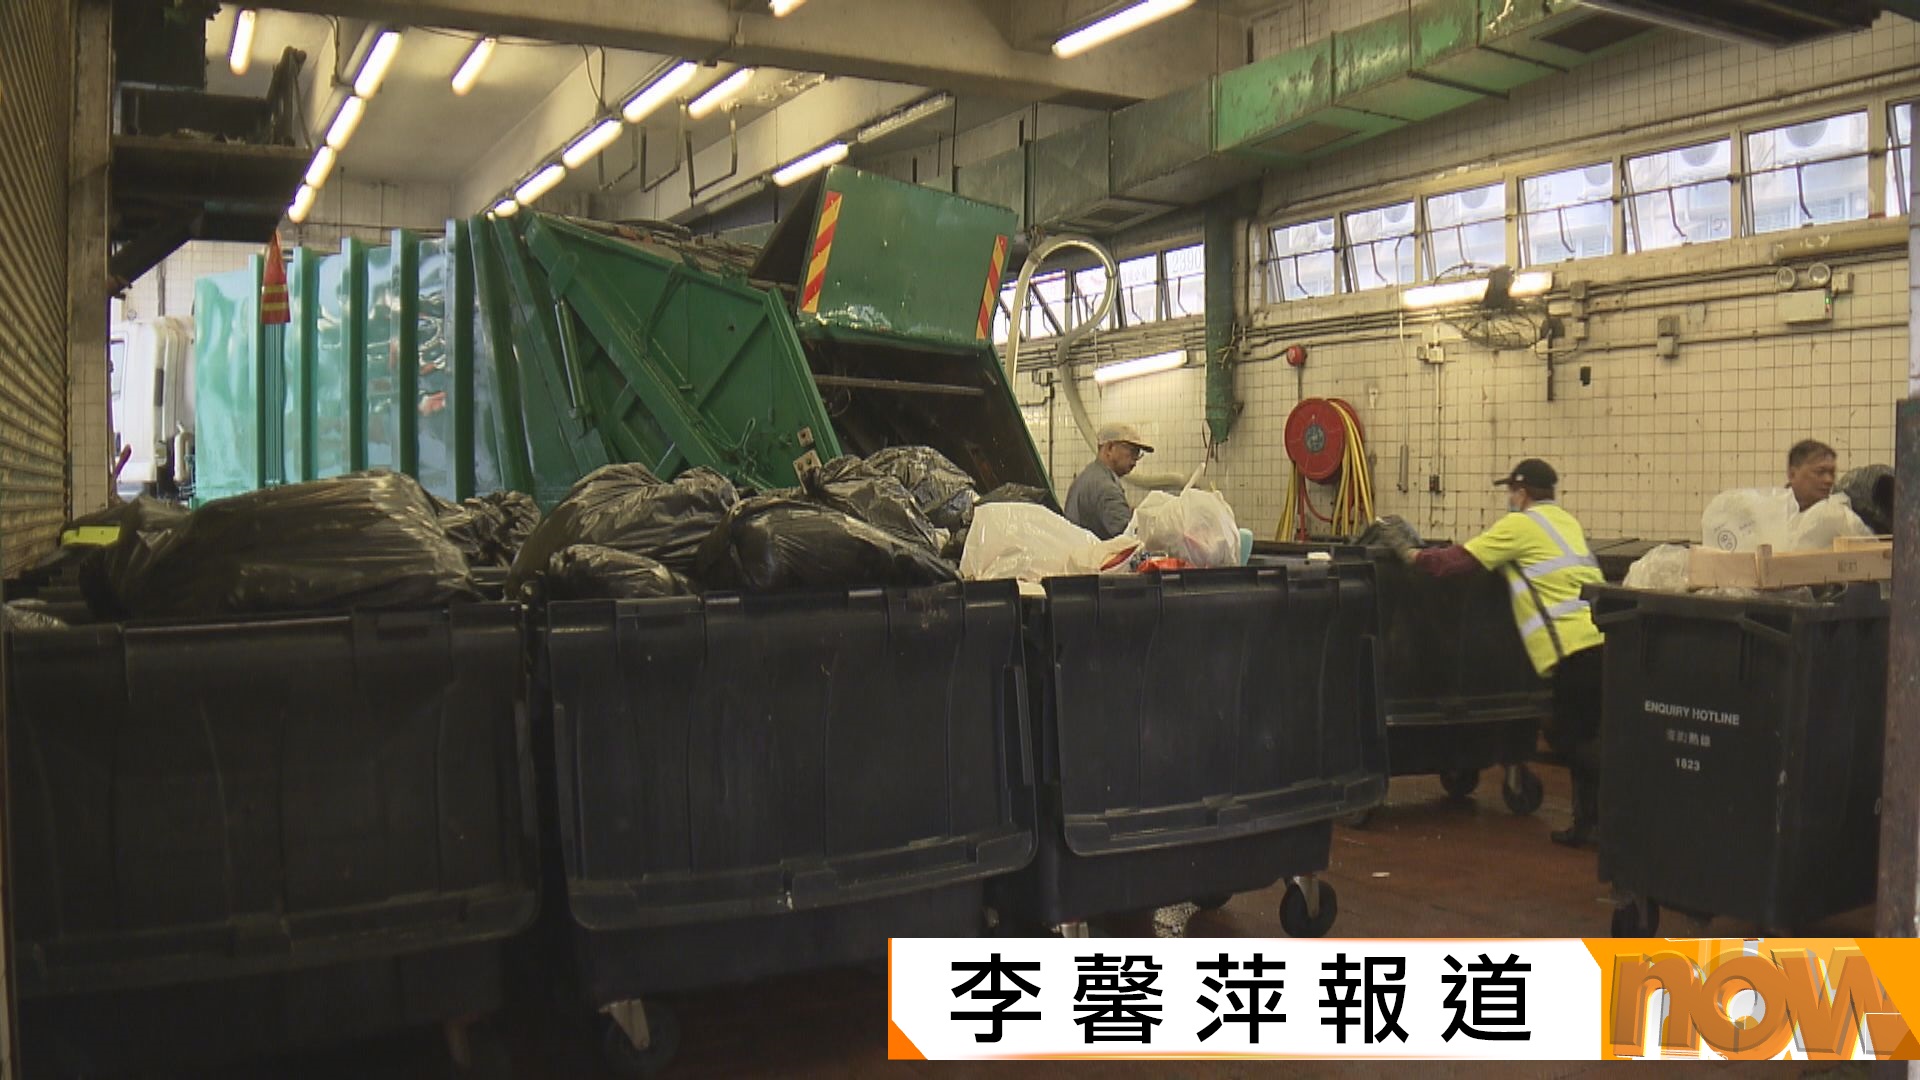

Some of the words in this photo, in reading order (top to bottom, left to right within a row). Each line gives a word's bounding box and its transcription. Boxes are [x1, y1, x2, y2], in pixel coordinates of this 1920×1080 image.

[1644, 700, 1690, 718] ENQUIRY
[1692, 709, 1740, 726] HOTLINE
[1675, 757, 1701, 771] 1823
